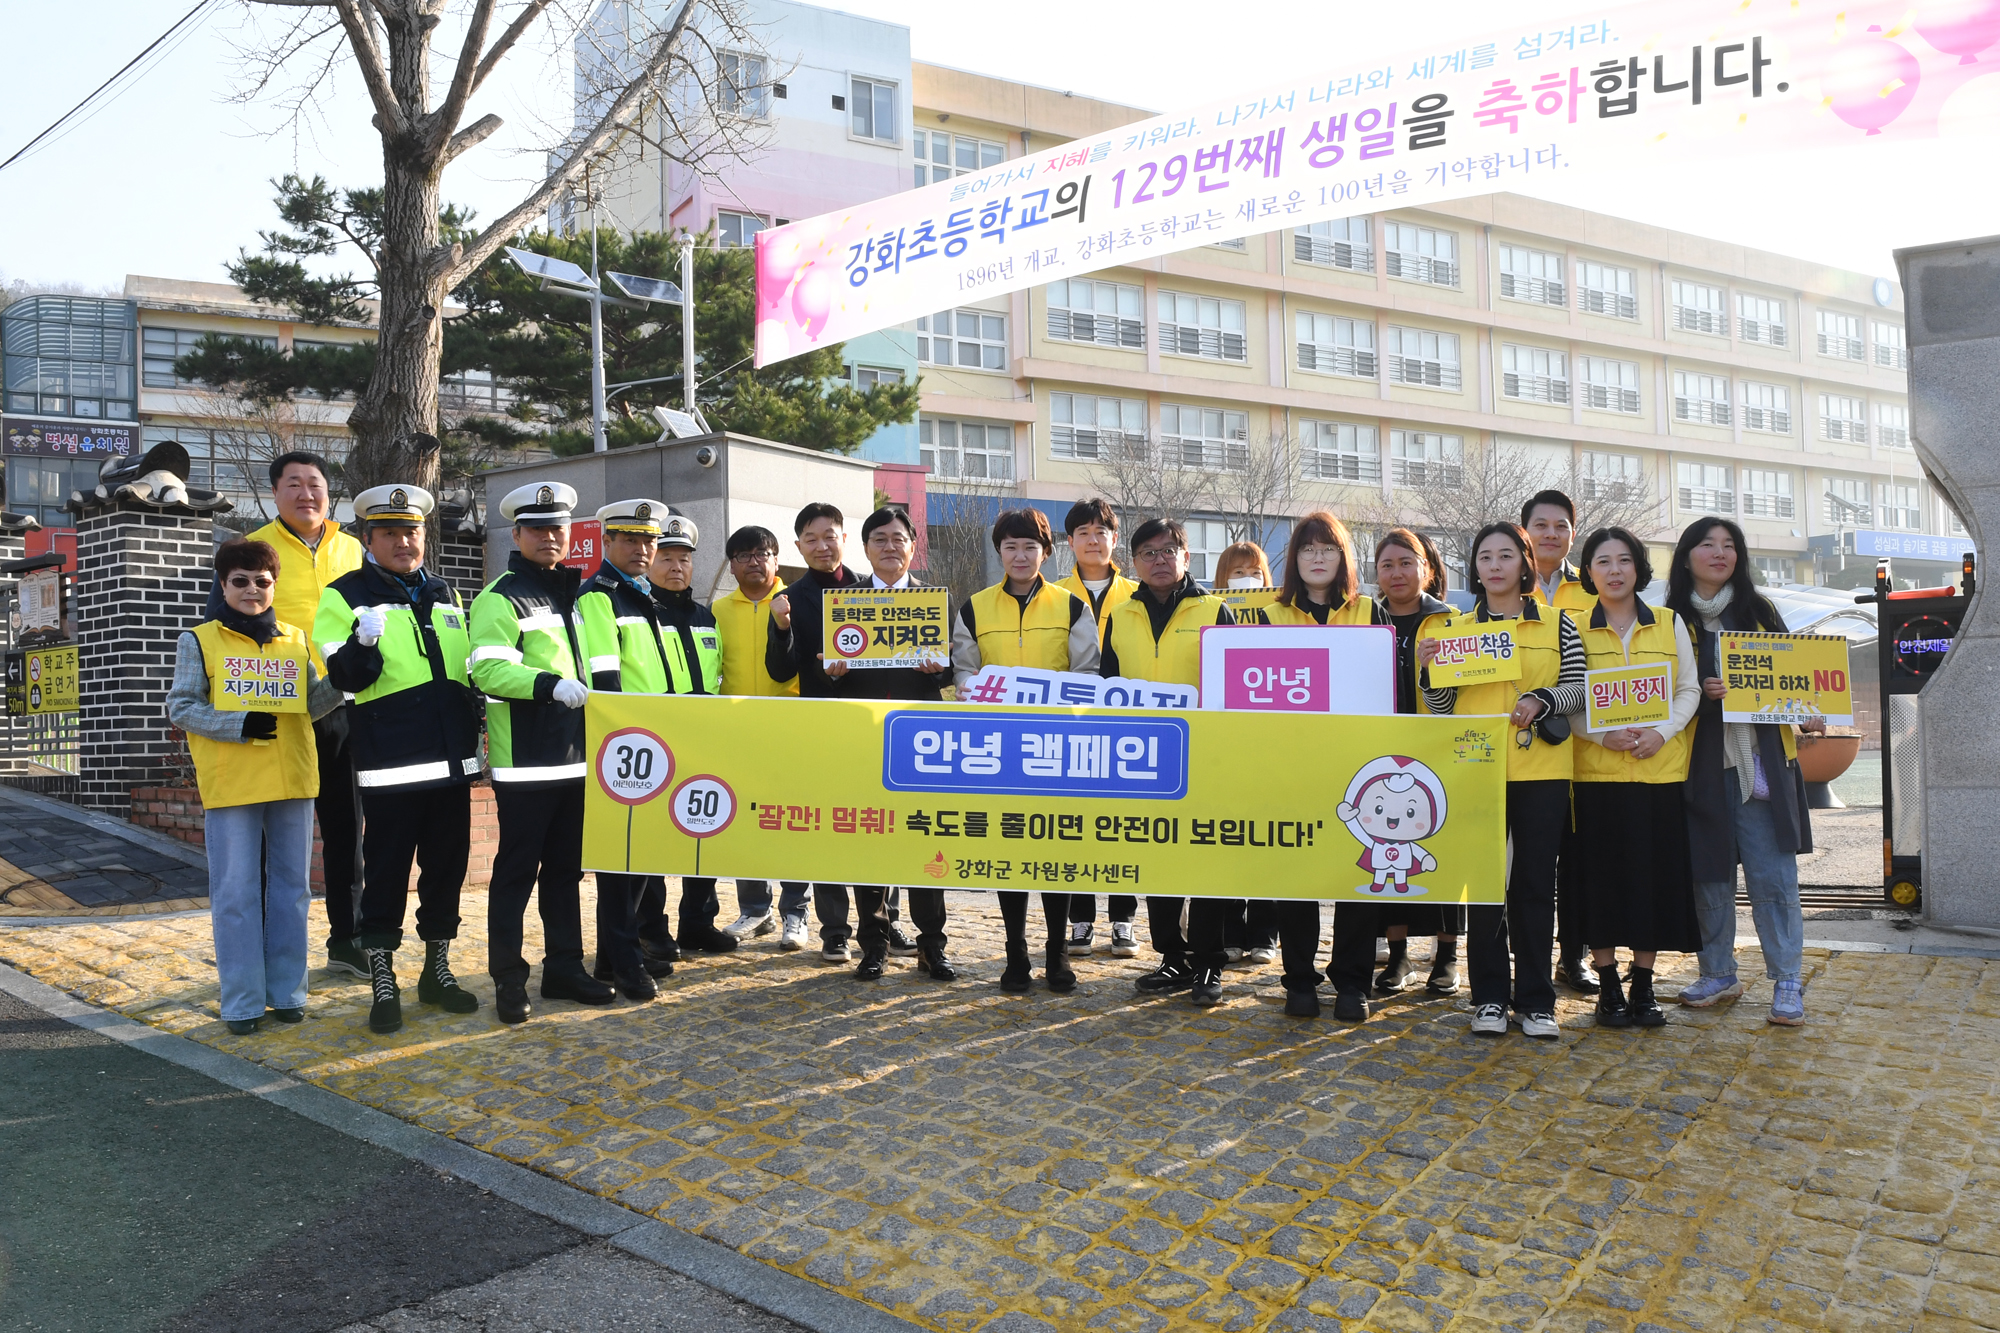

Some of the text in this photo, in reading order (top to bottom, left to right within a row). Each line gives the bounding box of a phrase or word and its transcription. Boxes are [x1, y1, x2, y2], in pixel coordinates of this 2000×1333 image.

[950, 19, 1620, 202] 들어가서 지혜를 키워라. 나가서 나라와 세계를 섬겨라.
[845, 36, 1790, 287] 강화초등학교의 129번째 생일을 축하합니다.
[957, 143, 1570, 292] 1896년 개교. 강화초등학교는 새로운 100년을 기약합니다.
[90, 427, 129, 436] 강화초등학교
[1873, 536, 1900, 552] 성실과
[1902, 538, 1929, 554] 슬기로
[1931, 541, 1948, 556] 꿈을
[843, 596, 895, 605] 교통안전 캠페인
[831, 606, 941, 622] 통학로 안전속도
[841, 634, 860, 645] 30
[872, 625, 942, 647] 지켜요
[1740, 641, 1793, 651] 교통안전 캠페인
[1899, 638, 1953, 654] 안전제일
[1434, 636, 1479, 665] 안전띠
[1480, 631, 1515, 660] 착용
[224, 656, 300, 680] 정지선을
[850, 659, 894, 668] 강화초등학교
[1727, 653, 1773, 671] 운전석
[224, 679, 299, 698] 지키세요
[1243, 667, 1311, 704] 안녕
[1728, 669, 1846, 692] 뒷자리 하차 NO
[1593, 675, 1666, 709] 일시 정지
[8, 698, 24, 713] 50m
[1750, 713, 1827, 723] 강화초등학교 학부회
[616, 745, 654, 780] 30
[913, 730, 1158, 780] 안녕 캠페인
[612, 780, 653, 790] 어린이보호
[687, 789, 719, 818] 50
[832, 807, 895, 834] 멈춰!
[906, 810, 989, 838] 속도를
[1000, 812, 1083, 841] 줄이면
[1095, 816, 1178, 844] 안전이
[955, 859, 1140, 884] 강화군 자원봉사센터
